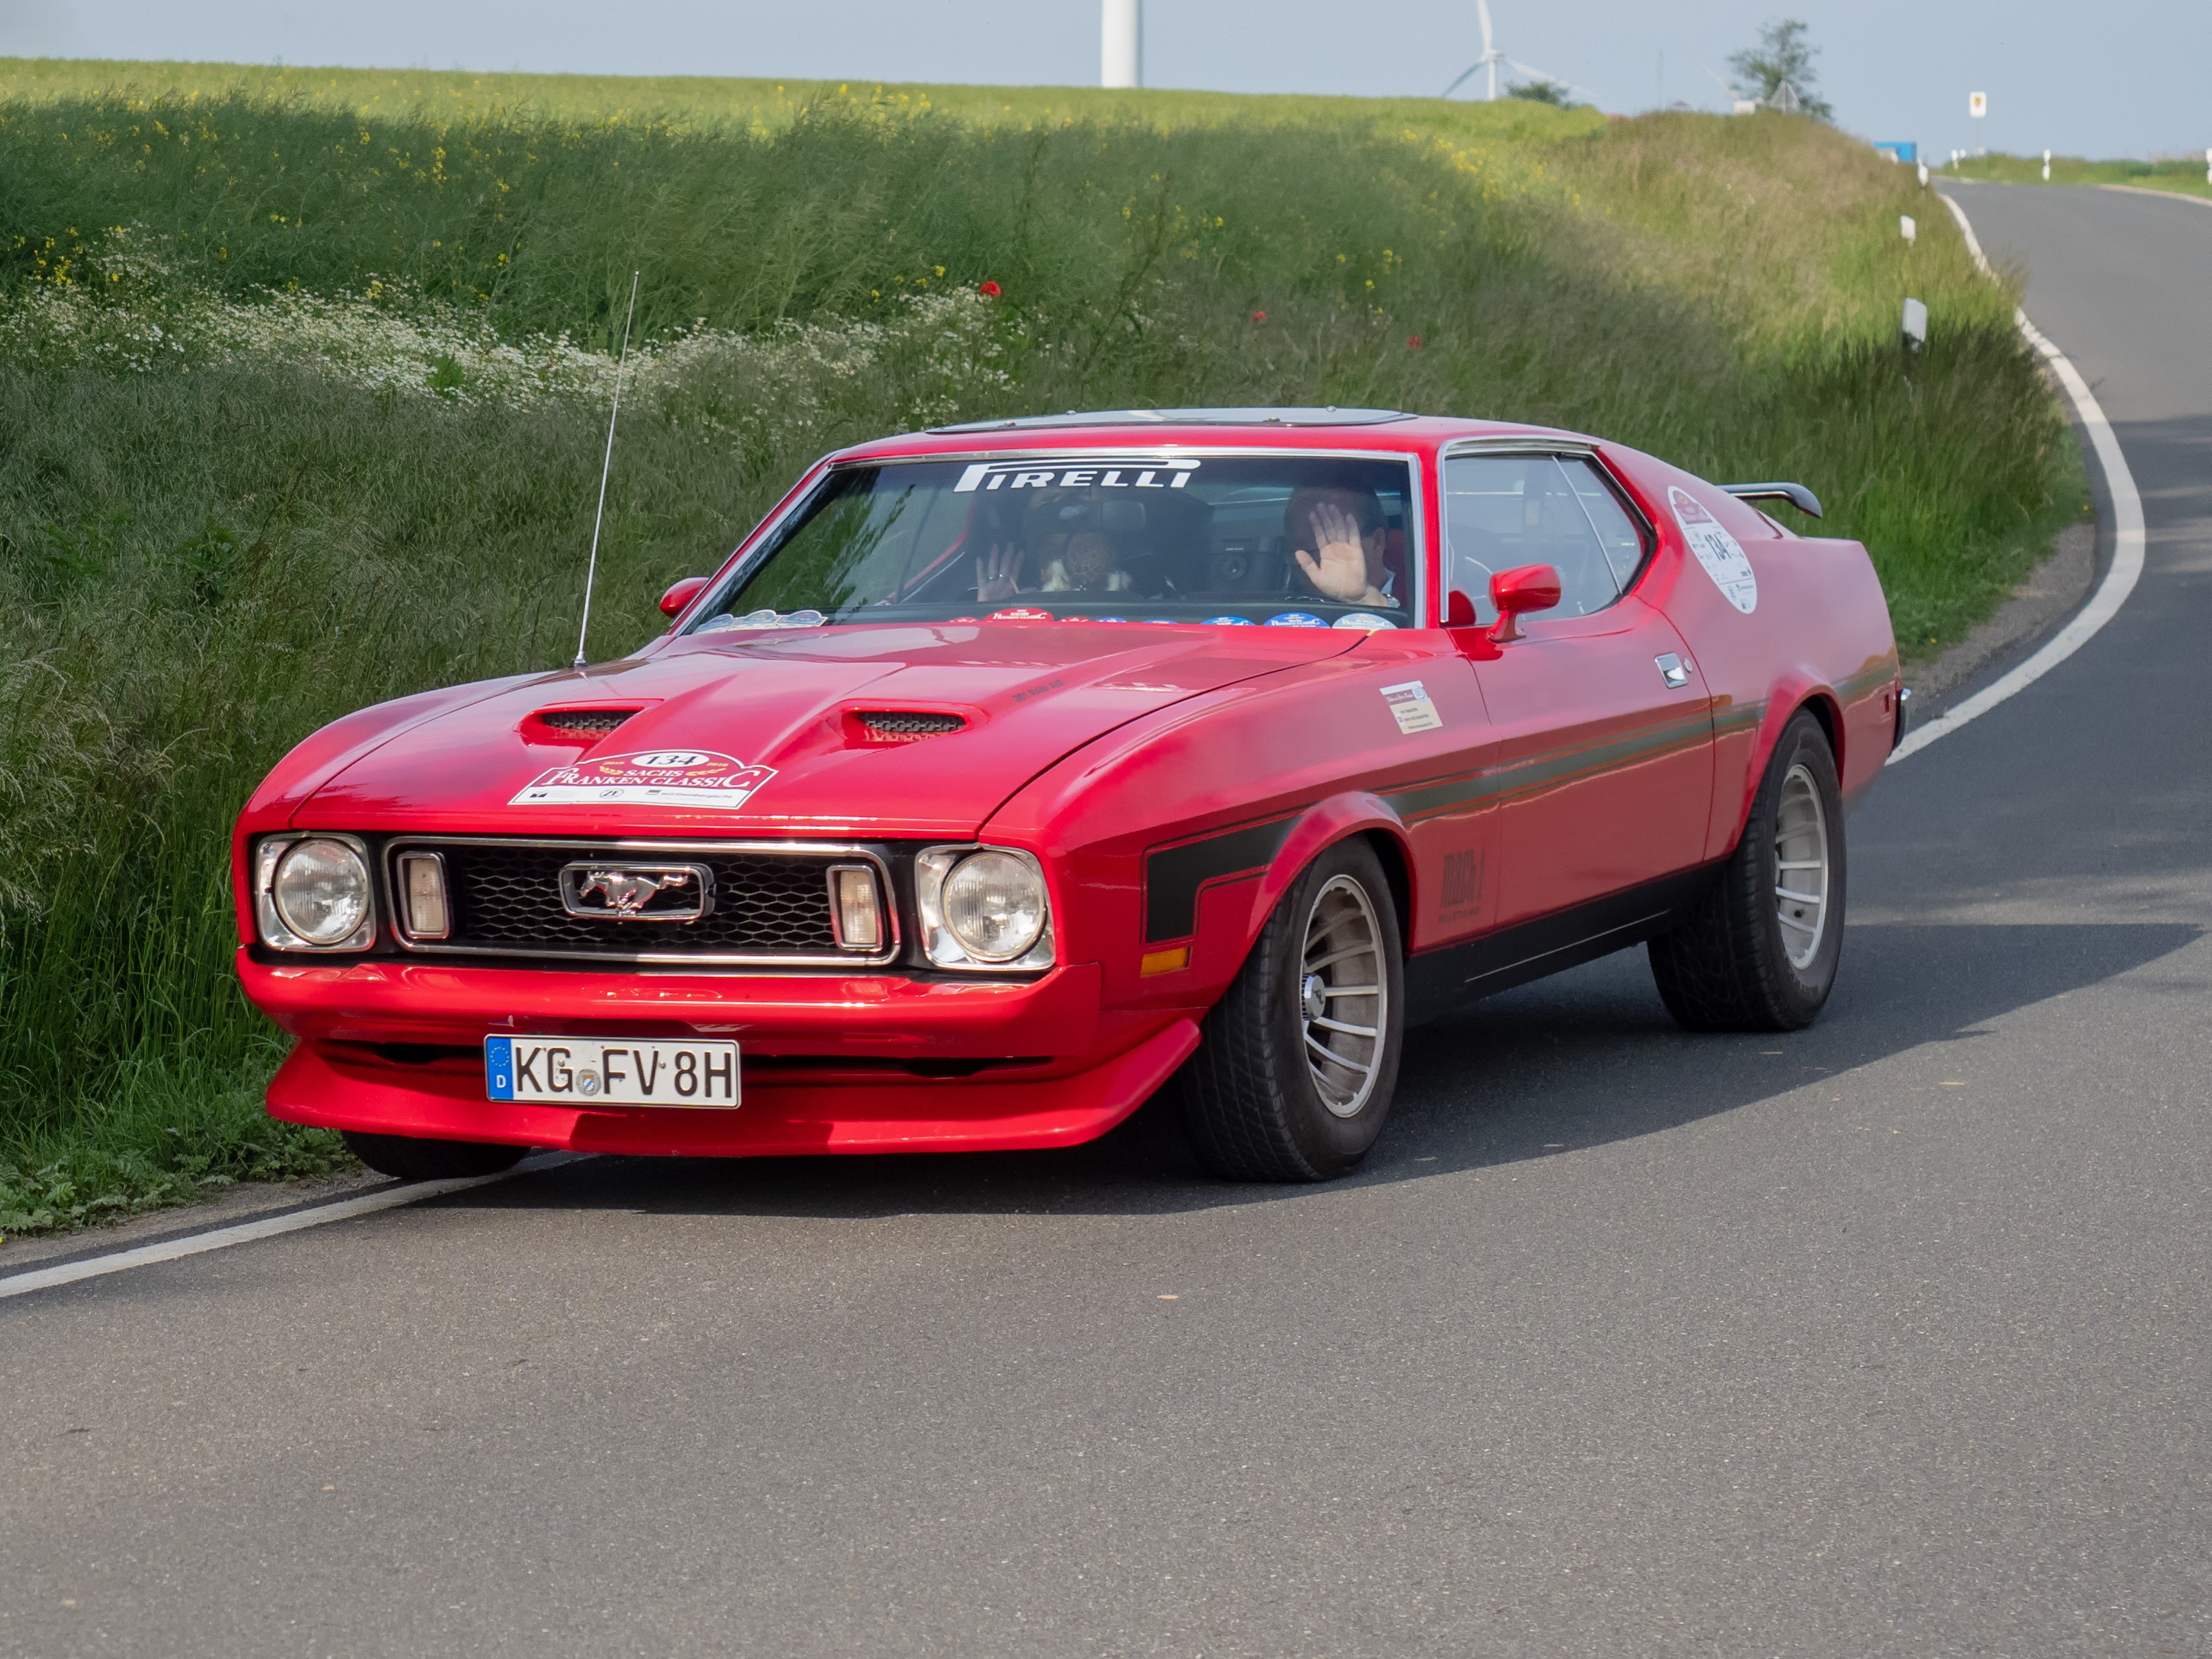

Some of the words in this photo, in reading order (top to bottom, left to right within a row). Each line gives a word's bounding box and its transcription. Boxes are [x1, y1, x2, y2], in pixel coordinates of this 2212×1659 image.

[954, 458, 1201, 492] PIRELLI
[646, 755, 698, 765] 134
[541, 767, 647, 786] FRANKEN
[649, 770, 760, 788] CLASSIC
[496, 1074, 506, 1088] D
[515, 1046, 574, 1093] KG
[602, 1049, 659, 1095] FV
[674, 1051, 732, 1098] 8H
